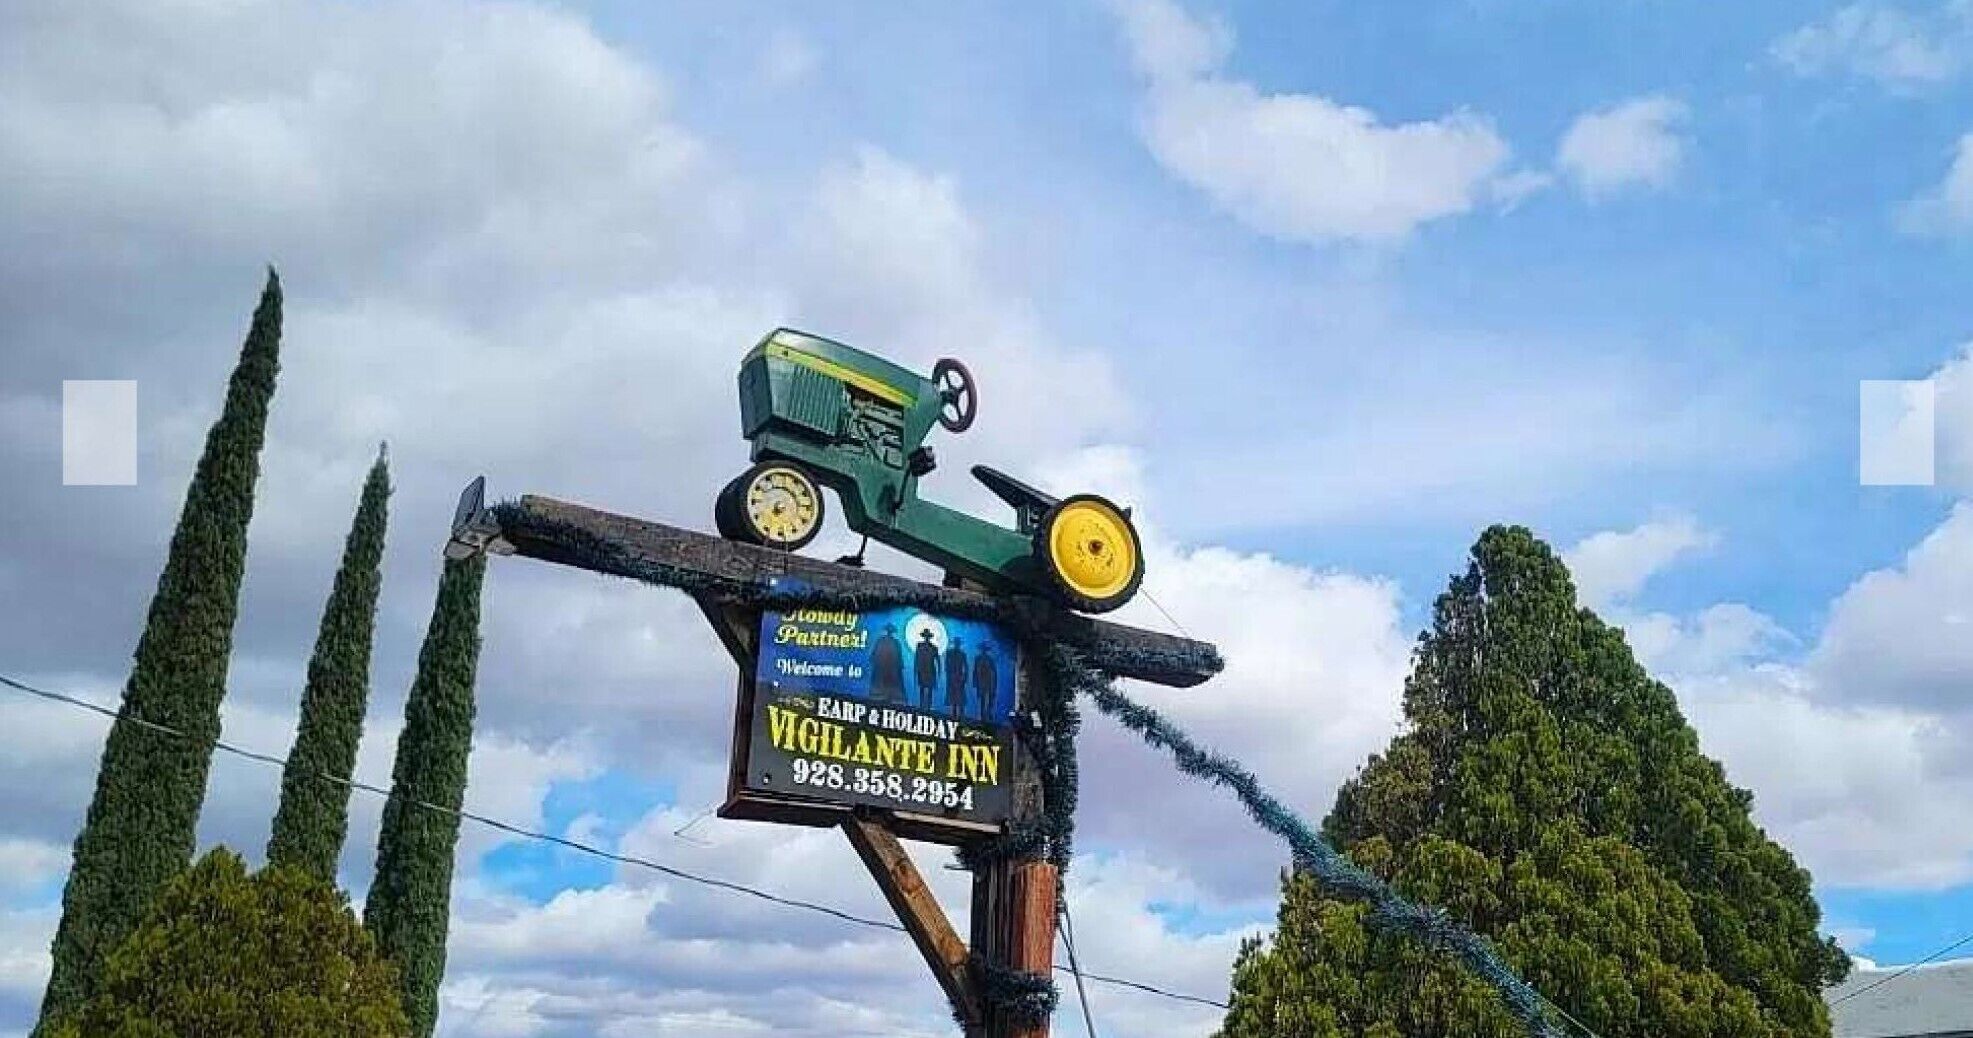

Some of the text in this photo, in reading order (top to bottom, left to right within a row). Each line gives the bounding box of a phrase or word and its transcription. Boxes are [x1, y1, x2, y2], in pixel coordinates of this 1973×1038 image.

[774, 625, 868, 648] Partner!
[777, 658, 862, 677] Welcome to
[817, 697, 959, 739] EARP & HOLIDAY
[768, 705, 1000, 786] VIGILANTE INN
[793, 758, 974, 810] 928.358.2954
